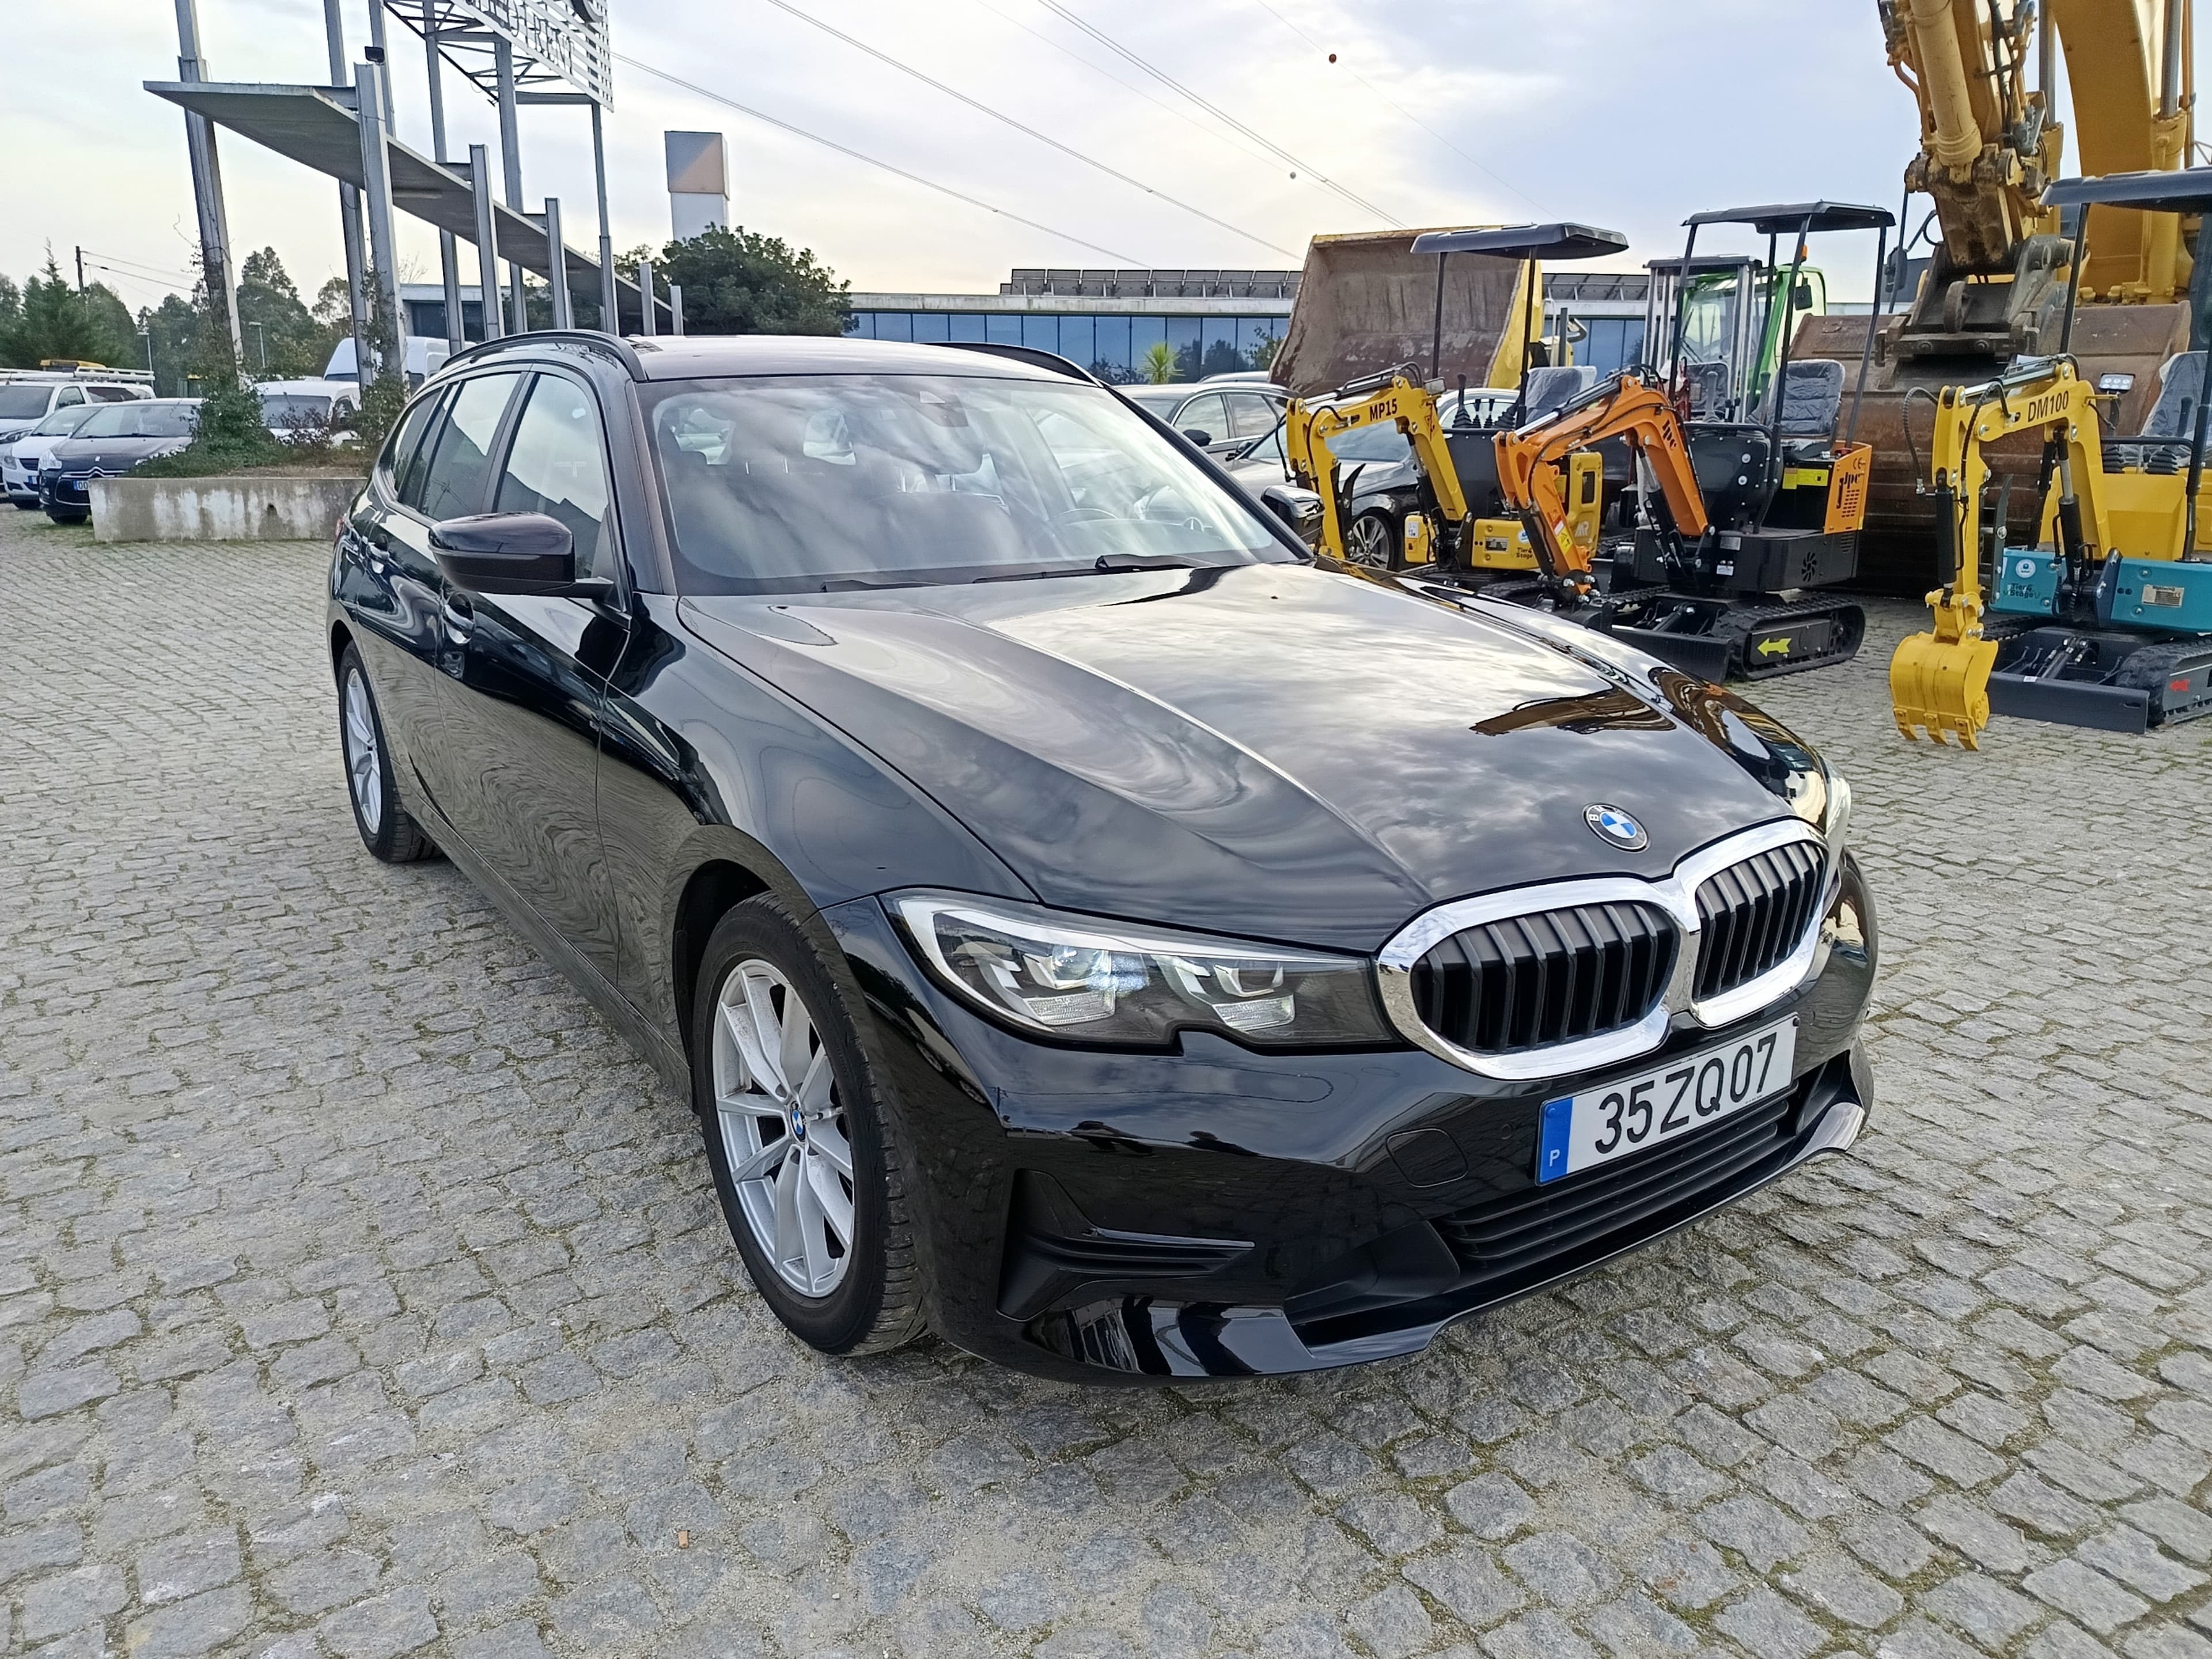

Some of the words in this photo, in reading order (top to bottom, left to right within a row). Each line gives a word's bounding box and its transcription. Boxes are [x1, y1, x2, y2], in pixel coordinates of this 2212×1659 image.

[1369, 398, 1397, 422] MP15
[2028, 390, 2069, 422] DM100
[1595, 1032, 1777, 1154] 35ZQ07
[1549, 1149, 1560, 1167] P
